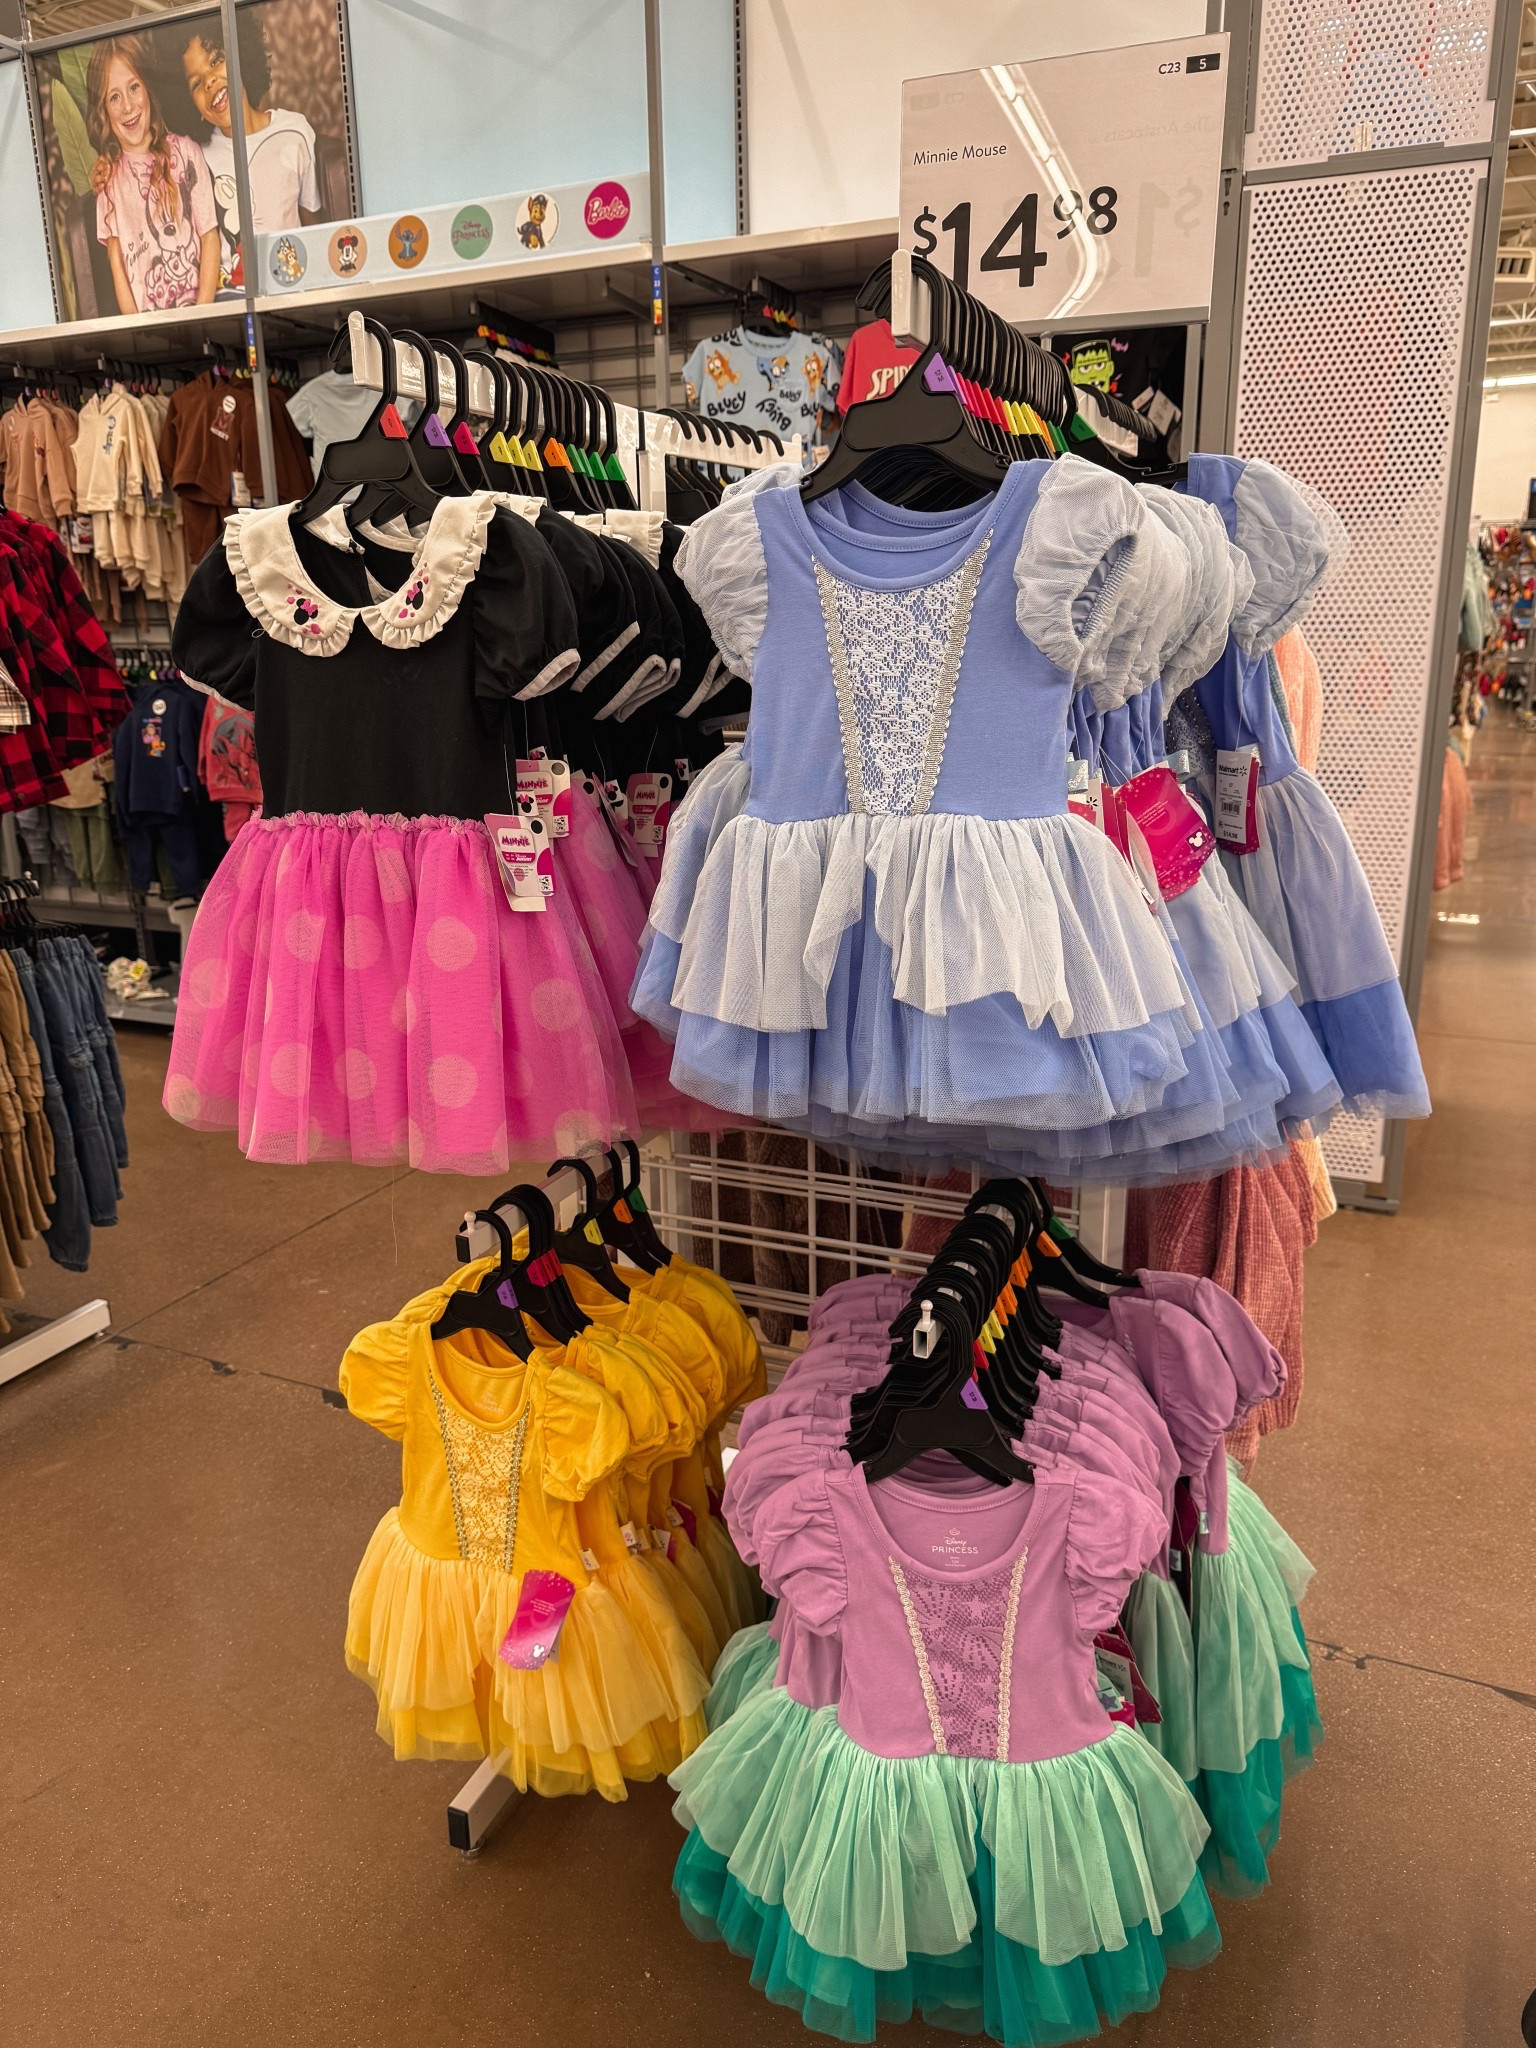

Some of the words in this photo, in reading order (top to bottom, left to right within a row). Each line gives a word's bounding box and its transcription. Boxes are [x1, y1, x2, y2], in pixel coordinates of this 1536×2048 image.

[1158, 61, 1182, 75] C23
[1199, 58, 1207, 70] 5
[913, 147, 958, 166] Minnie
[962, 144, 1007, 160] Mouse
[587, 196, 628, 225] Barbie
[865, 364, 913, 401] SPID
[1218, 764, 1239, 774] Walmart
[501, 835, 530, 847] MINNIE
[943, 1536, 967, 1547] Disney
[931, 1545, 979, 1554] PRINCESS
